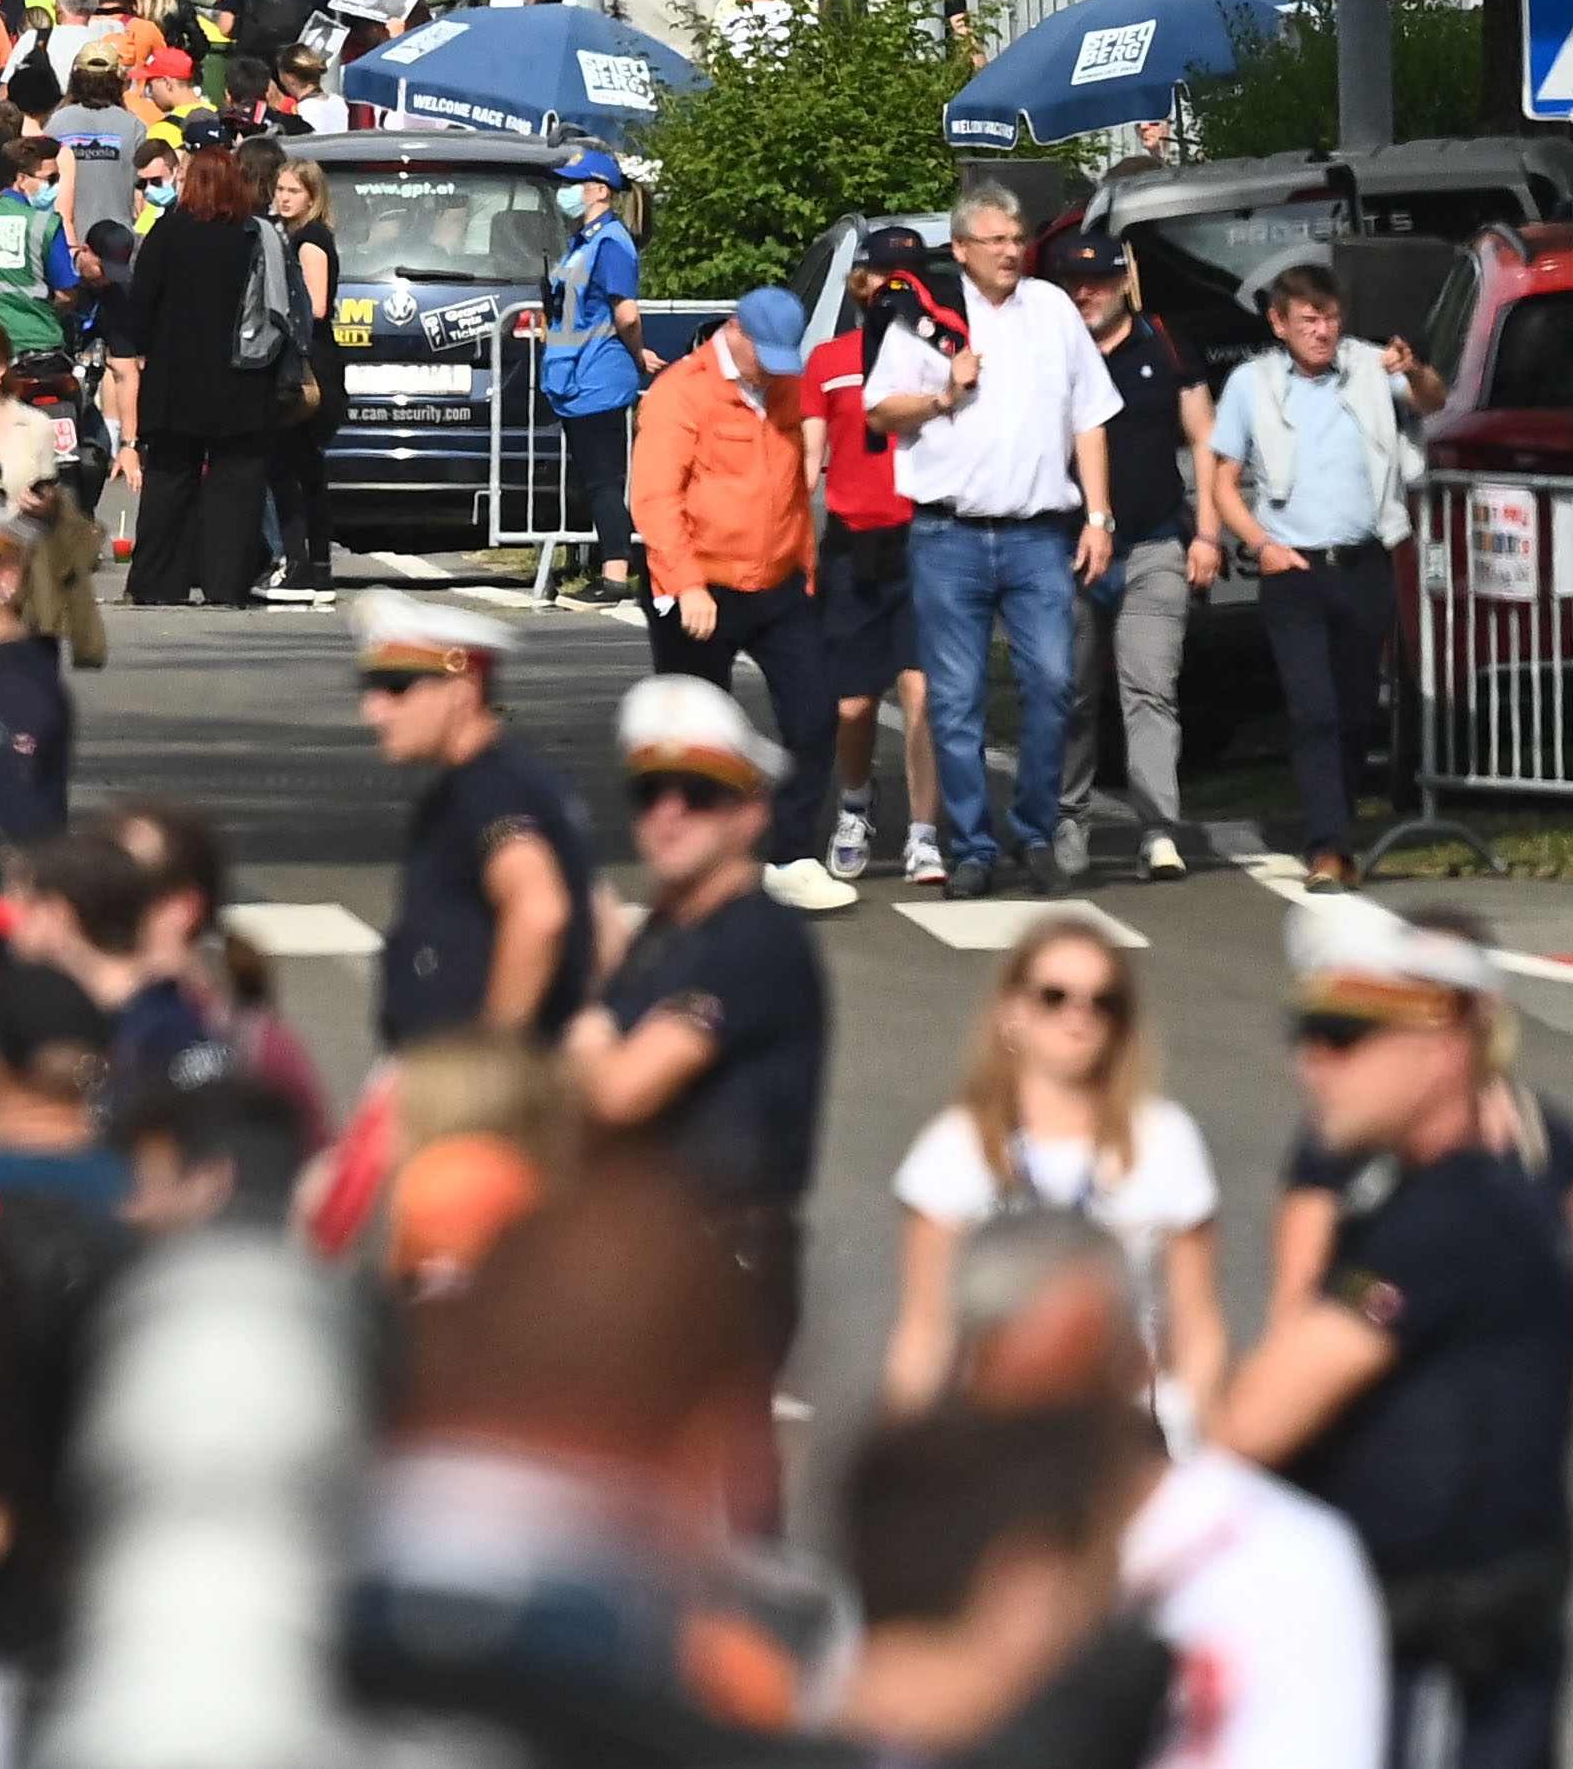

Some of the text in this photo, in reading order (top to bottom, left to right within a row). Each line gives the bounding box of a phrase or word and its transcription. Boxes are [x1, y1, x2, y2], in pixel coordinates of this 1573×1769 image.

[413, 94, 472, 118] WELCOME
[472, 105, 505, 128] RACE
[354, 182, 455, 198] www.gpt.at
